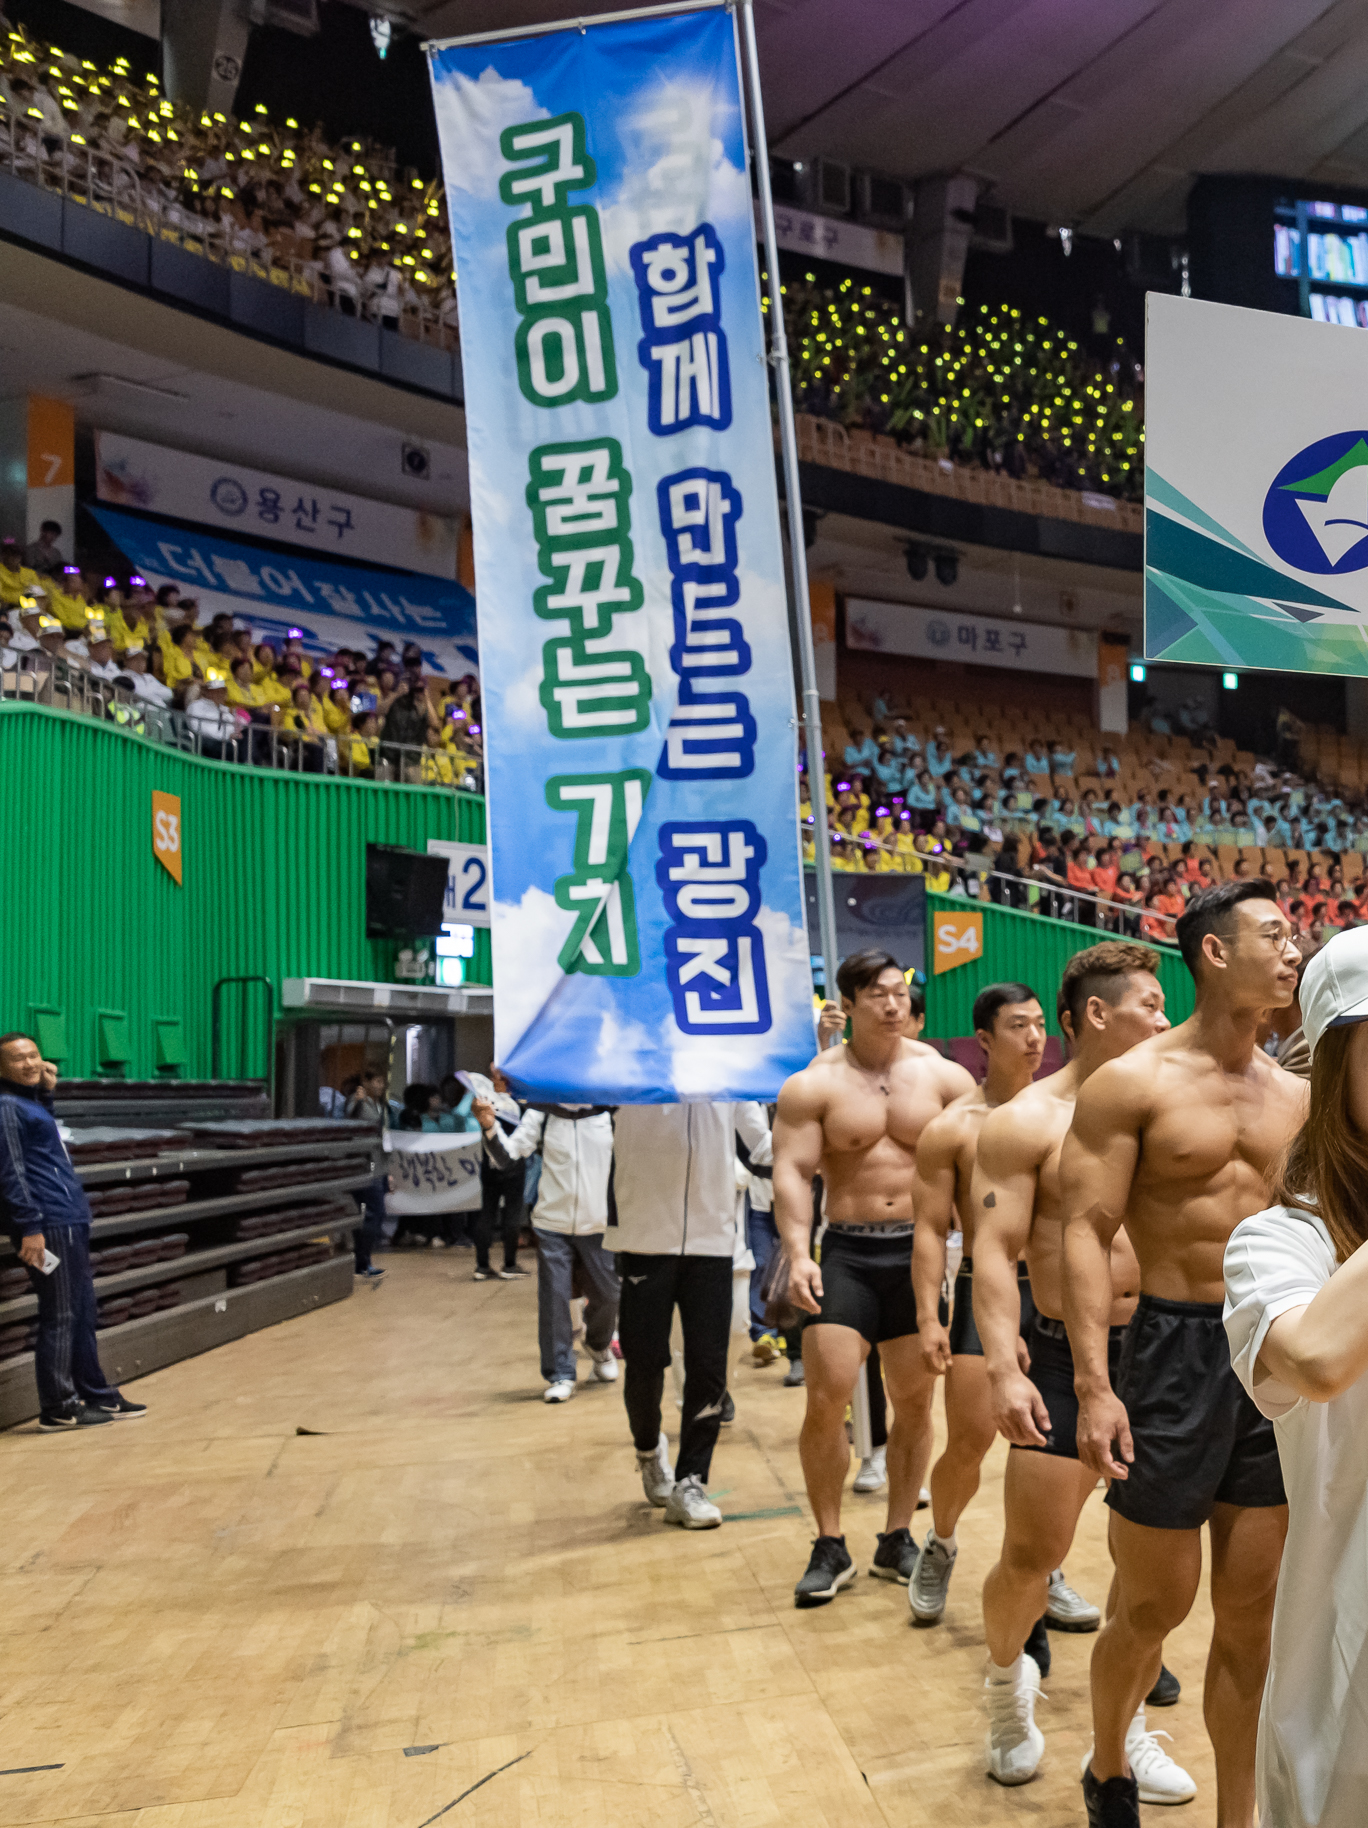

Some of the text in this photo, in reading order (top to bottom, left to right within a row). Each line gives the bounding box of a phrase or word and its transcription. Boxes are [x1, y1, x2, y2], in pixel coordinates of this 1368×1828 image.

[505, 117, 612, 402] 구민이
[40, 454, 61, 484] 7
[256, 487, 355, 537] 용산구
[533, 443, 645, 732] 꿈꾸는
[636, 229, 766, 1028] 함께 만드는 광진
[957, 624, 1028, 657] 마포구
[156, 810, 179, 852] S3
[937, 924, 979, 954] S4
